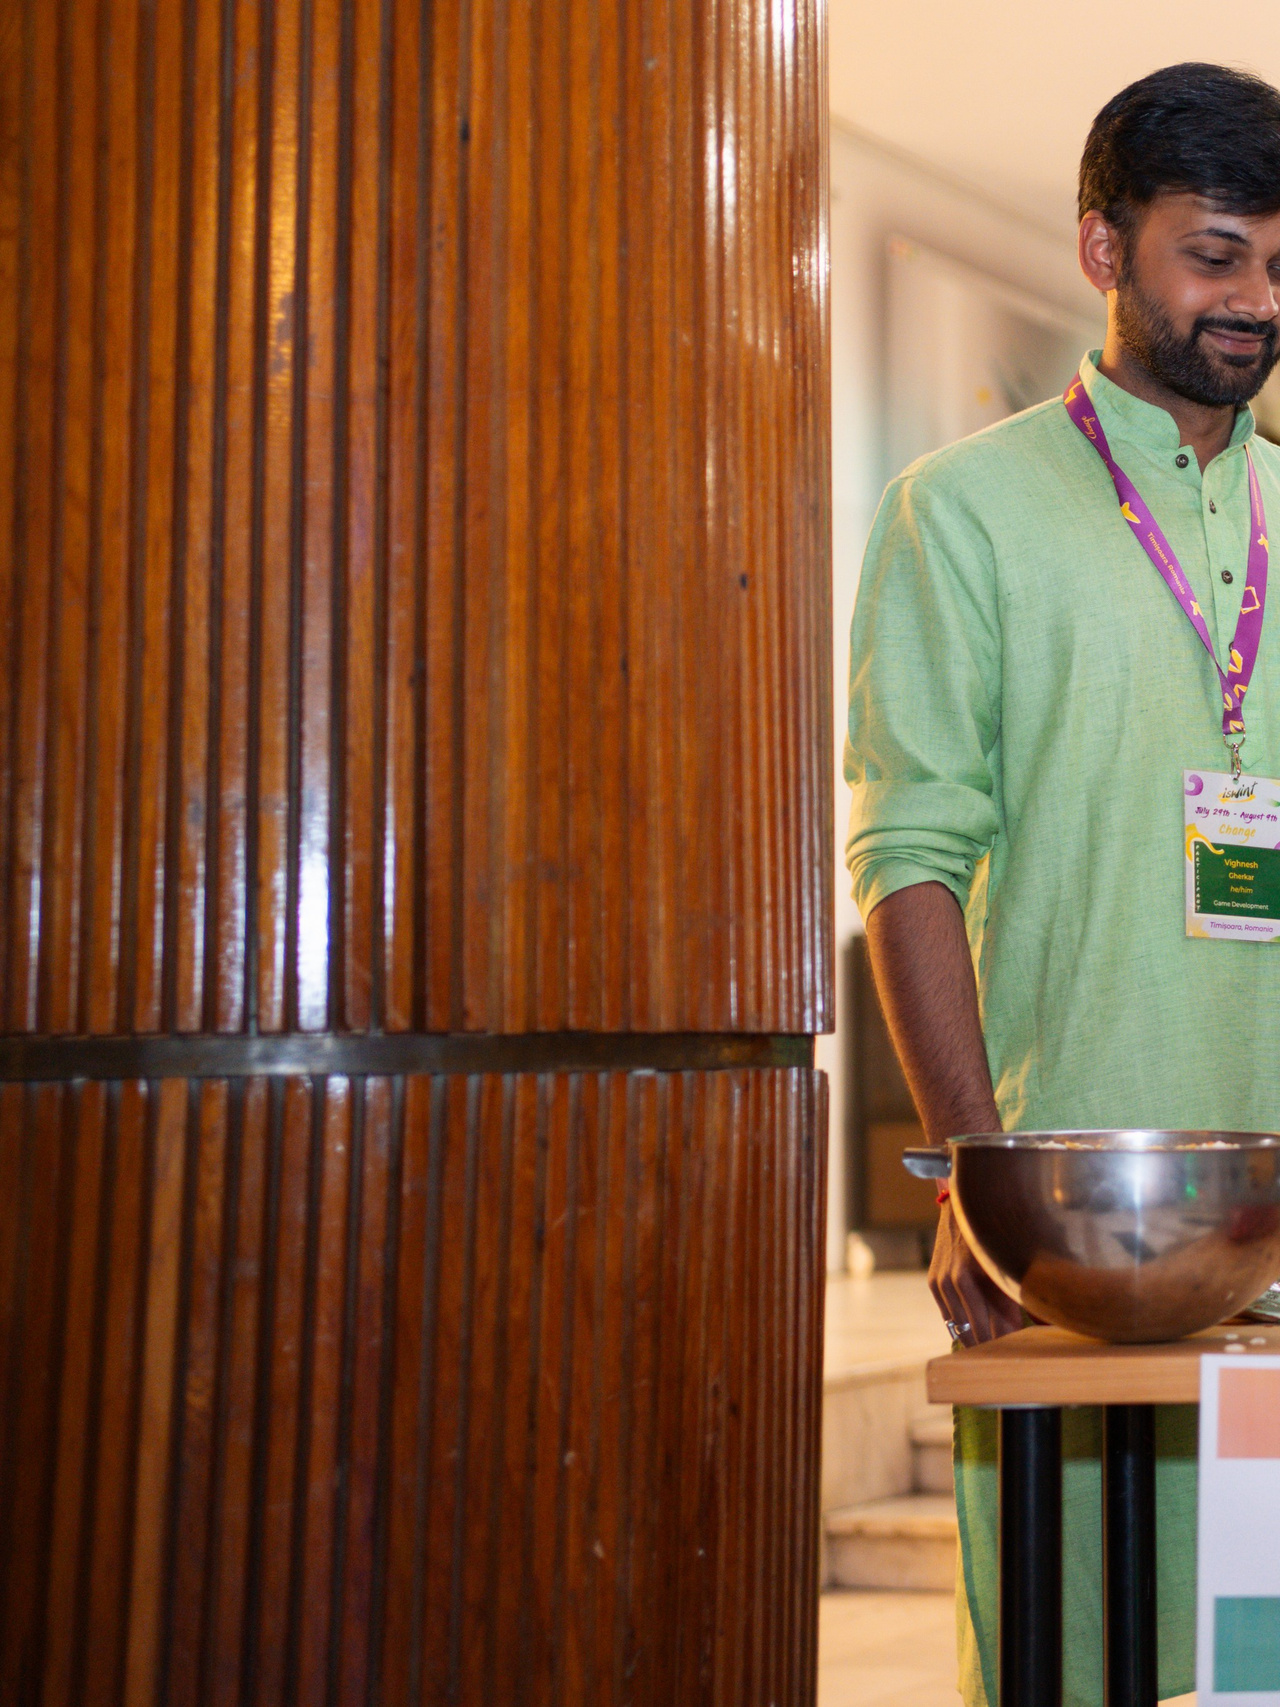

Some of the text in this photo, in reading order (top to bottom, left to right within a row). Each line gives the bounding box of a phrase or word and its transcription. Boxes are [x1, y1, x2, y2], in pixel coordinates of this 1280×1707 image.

[1167, 564, 1186, 595] Romania
[1195, 806, 1210, 818] July
[1212, 808, 1231, 817] 29th
[1239, 811, 1264, 824] August
[1219, 823, 1256, 844] Change
[1224, 858, 1259, 869] Vighnesh
[1230, 885, 1253, 894] he/him
[1231, 901, 1269, 911] Development
[1244, 924, 1274, 933] Romania
